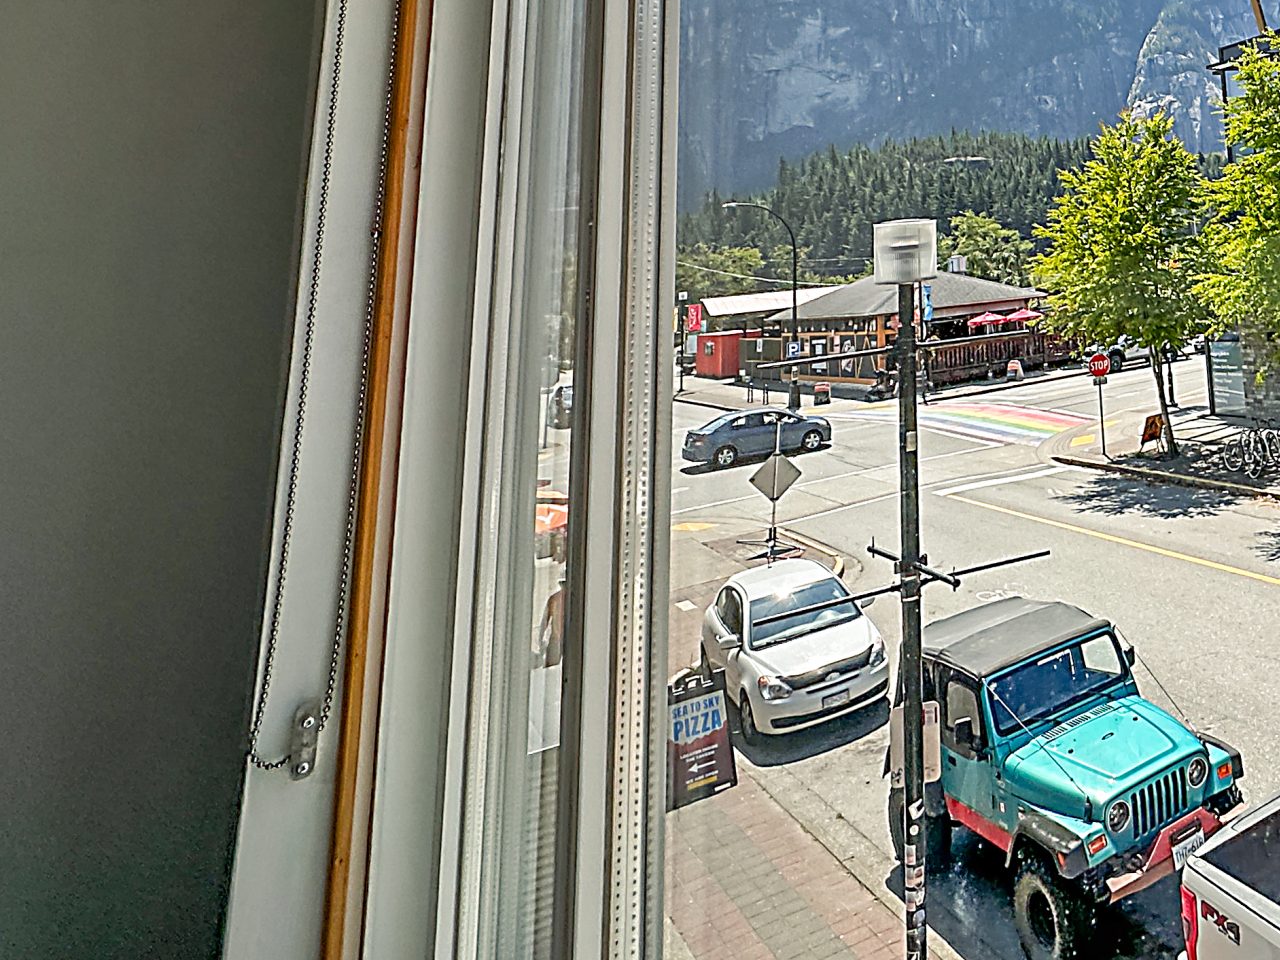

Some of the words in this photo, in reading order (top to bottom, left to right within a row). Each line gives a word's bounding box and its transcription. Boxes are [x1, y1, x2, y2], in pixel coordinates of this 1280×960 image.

[1090, 360, 1109, 371] STOP
[672, 705, 688, 720] SEA
[690, 701, 700, 713] TO
[703, 696, 720, 710] SKY
[673, 709, 723, 741] PIZZA
